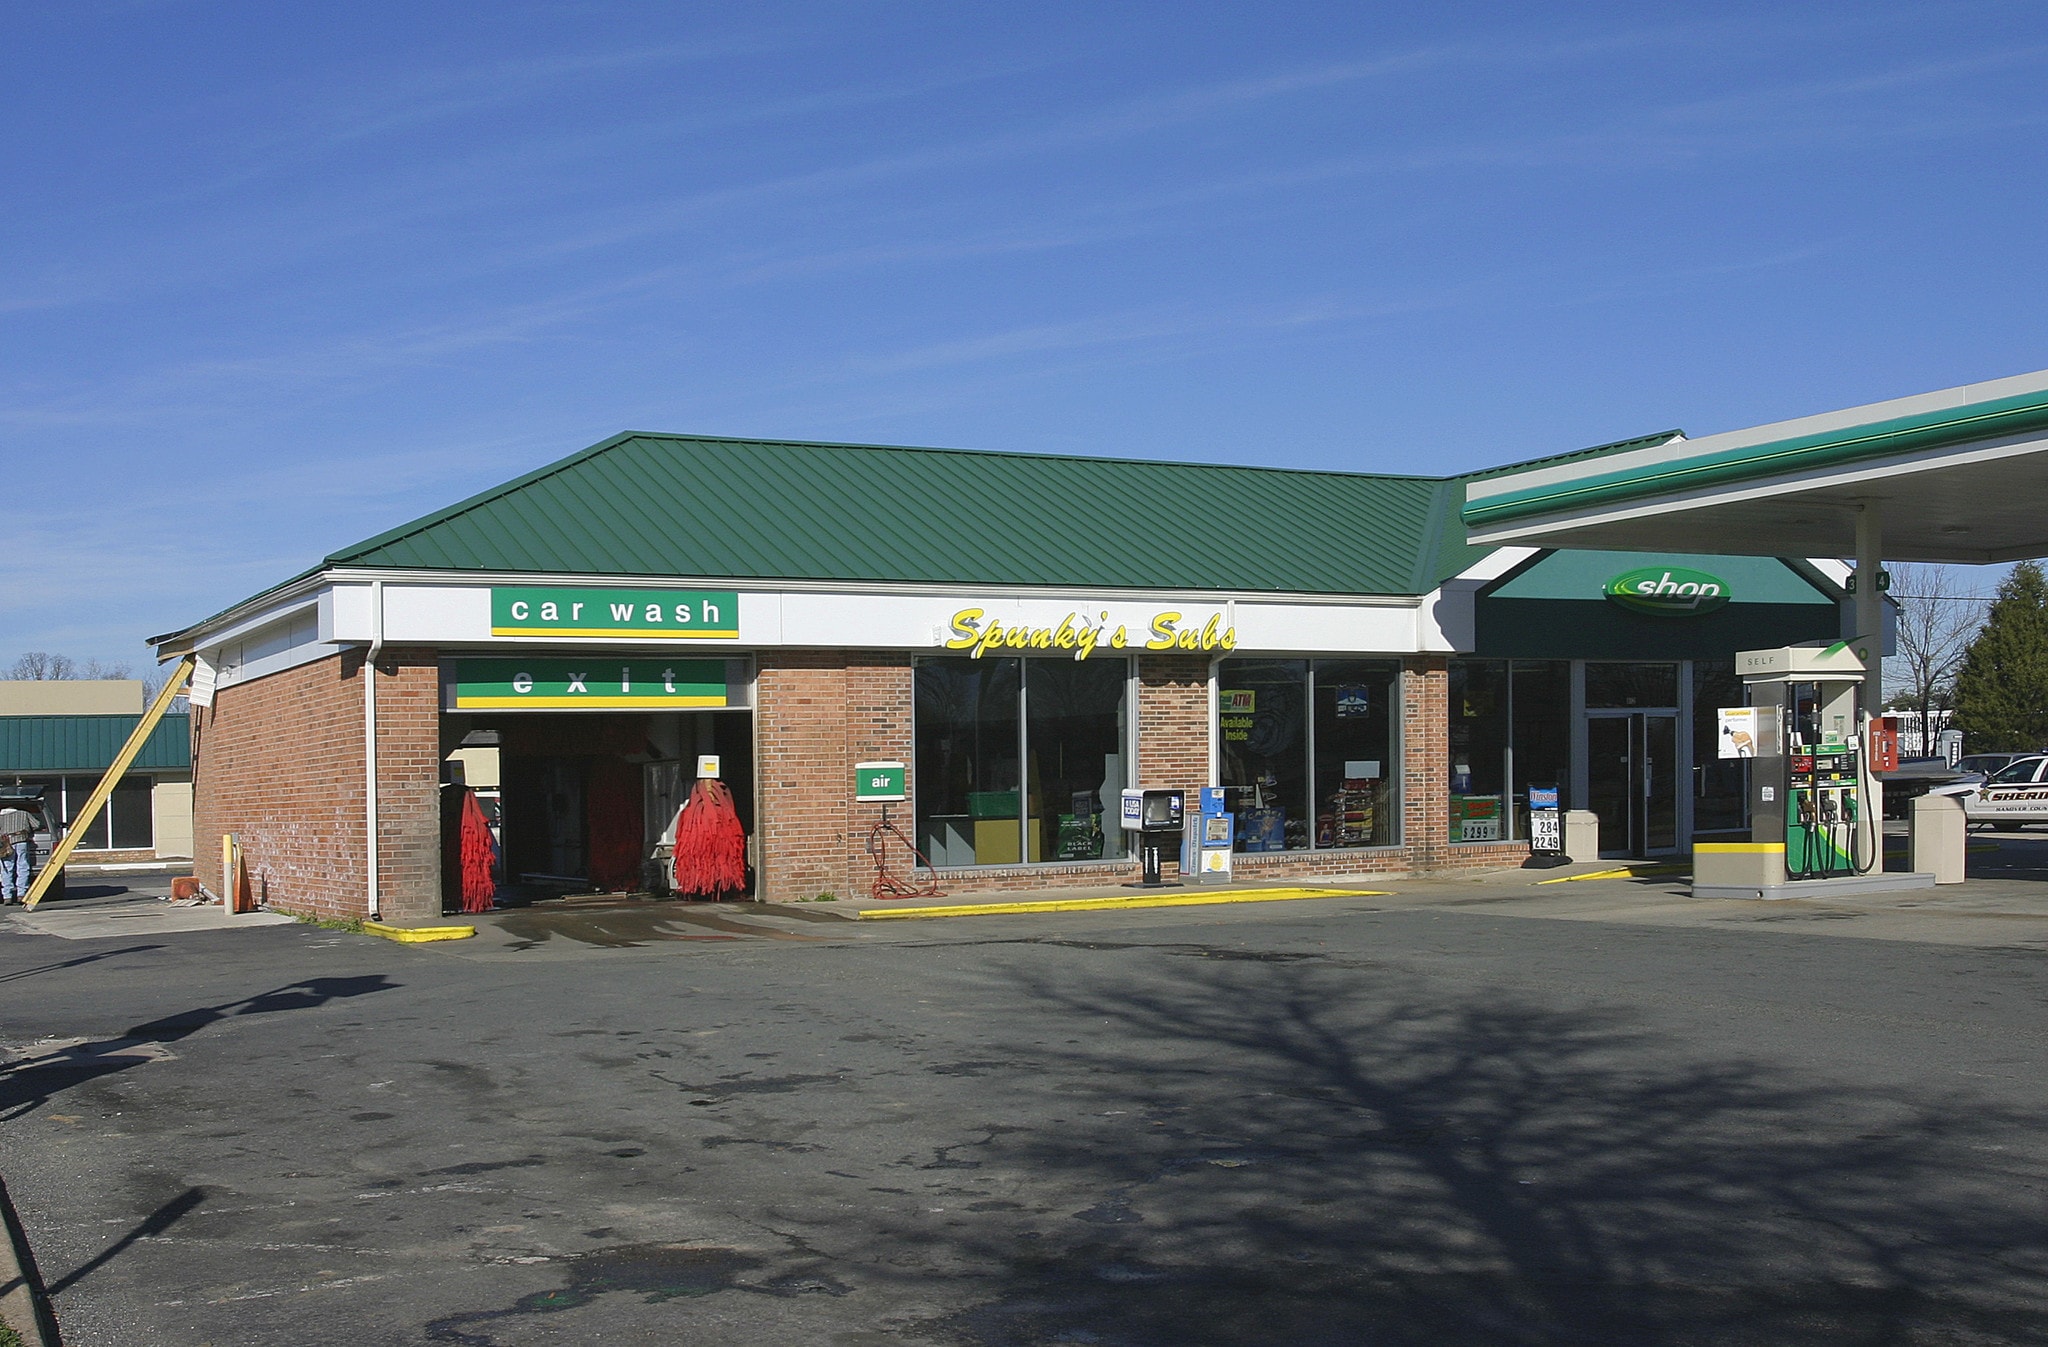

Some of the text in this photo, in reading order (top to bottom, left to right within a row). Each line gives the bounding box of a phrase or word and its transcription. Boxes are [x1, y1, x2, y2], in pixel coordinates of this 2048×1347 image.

[1879, 576, 1885, 587] 4
[1637, 572, 1720, 609] shop
[511, 599, 720, 623] car wash
[946, 608, 1238, 660] Spunky's Subs
[1747, 656, 1774, 666] SELF
[512, 667, 676, 694] exit
[1232, 694, 1252, 706] ATM
[1221, 716, 1253, 728] Available
[1226, 729, 1248, 740] Inside
[872, 774, 891, 788] air
[1530, 791, 1557, 802] Winston
